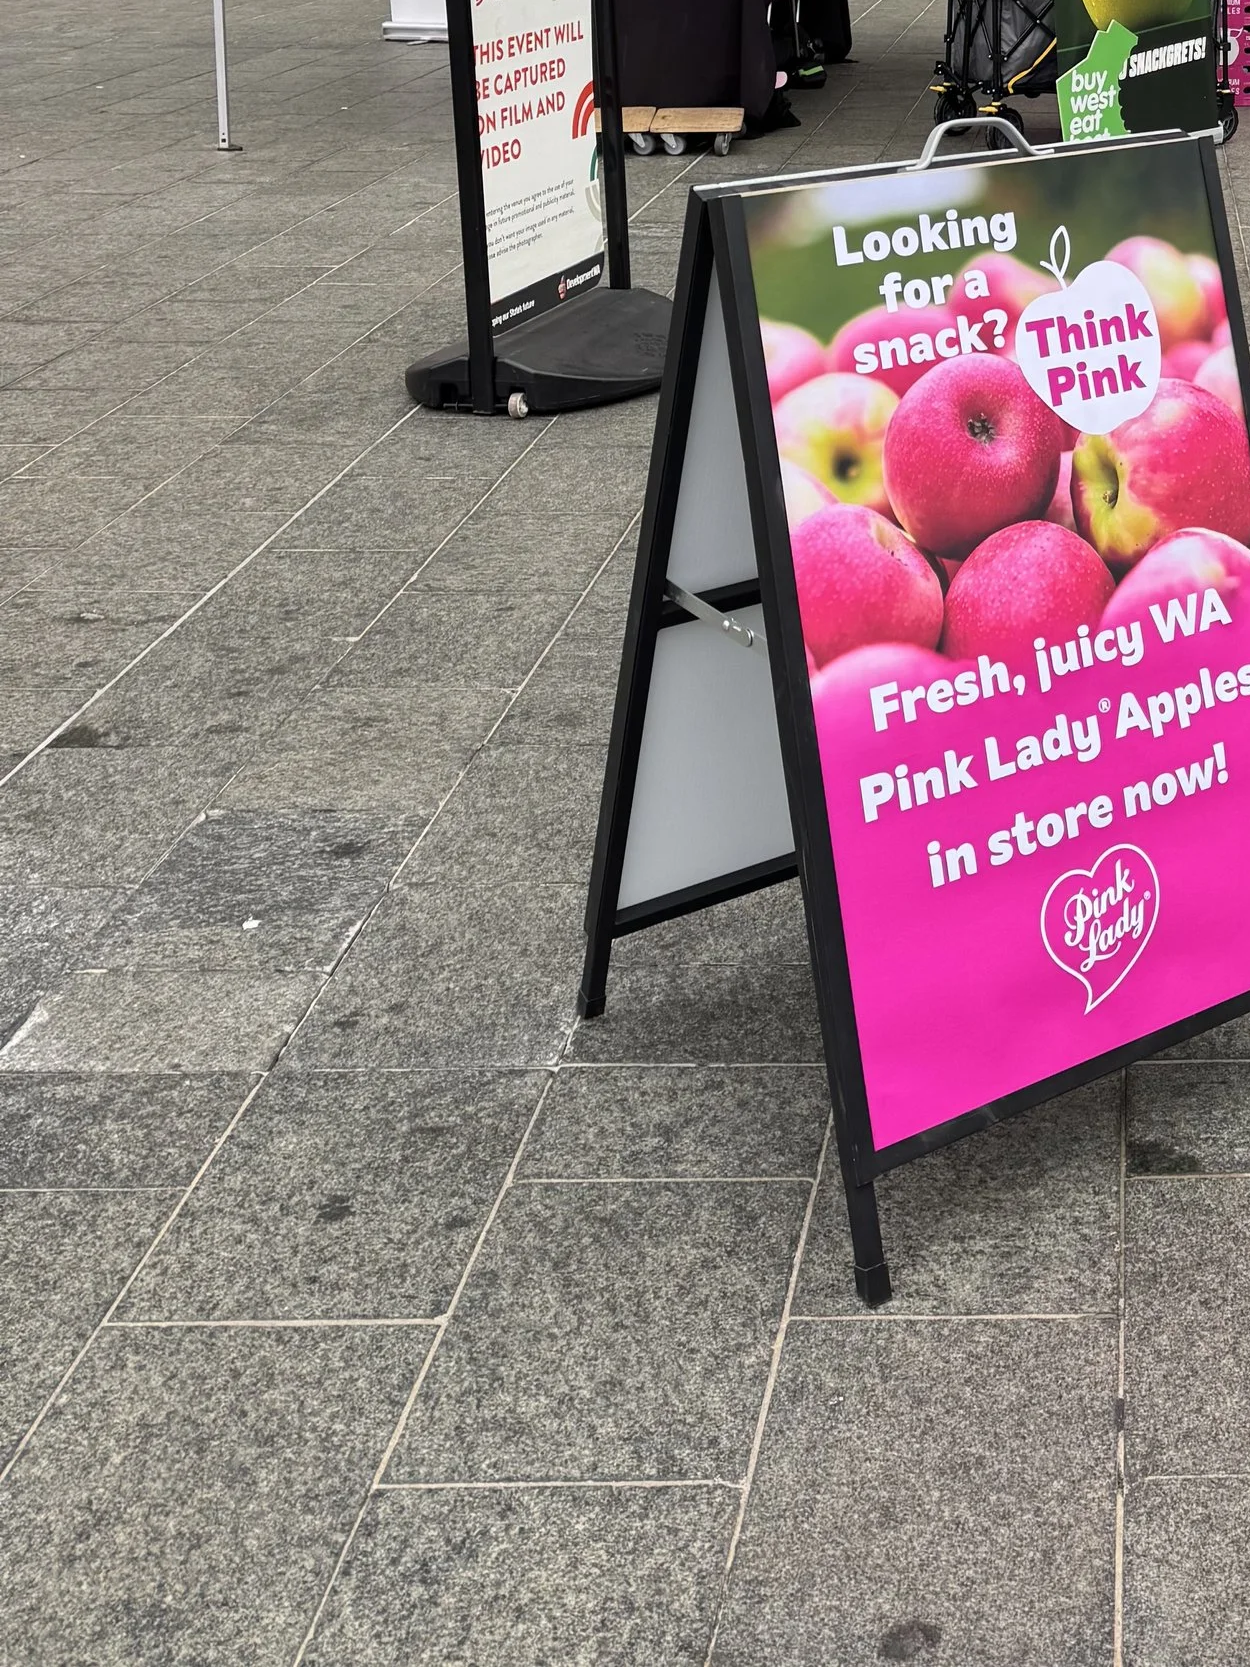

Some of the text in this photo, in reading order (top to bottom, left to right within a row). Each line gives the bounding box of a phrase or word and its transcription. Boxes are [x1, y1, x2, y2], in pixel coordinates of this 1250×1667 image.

[473, 20, 584, 66] THIS EVENT WILL
[1128, 37, 1207, 78] SNACKGRETS!
[493, 57, 566, 96] CAPTURED
[1070, 85, 1116, 113] west
[1071, 70, 1108, 94] buy
[501, 101, 533, 129] FILM
[536, 91, 565, 116] AND
[1069, 109, 1103, 135] eat
[832, 208, 1018, 266] Looking
[879, 269, 990, 314] for a
[853, 308, 1009, 375] snack?
[1025, 303, 1154, 359] Think
[1047, 354, 1147, 407] Pink
[869, 587, 1233, 733] Fresh, juicy WA
[859, 749, 979, 824] Pink
[926, 742, 1229, 888] in store now!
[1063, 858, 1135, 947] Pink
